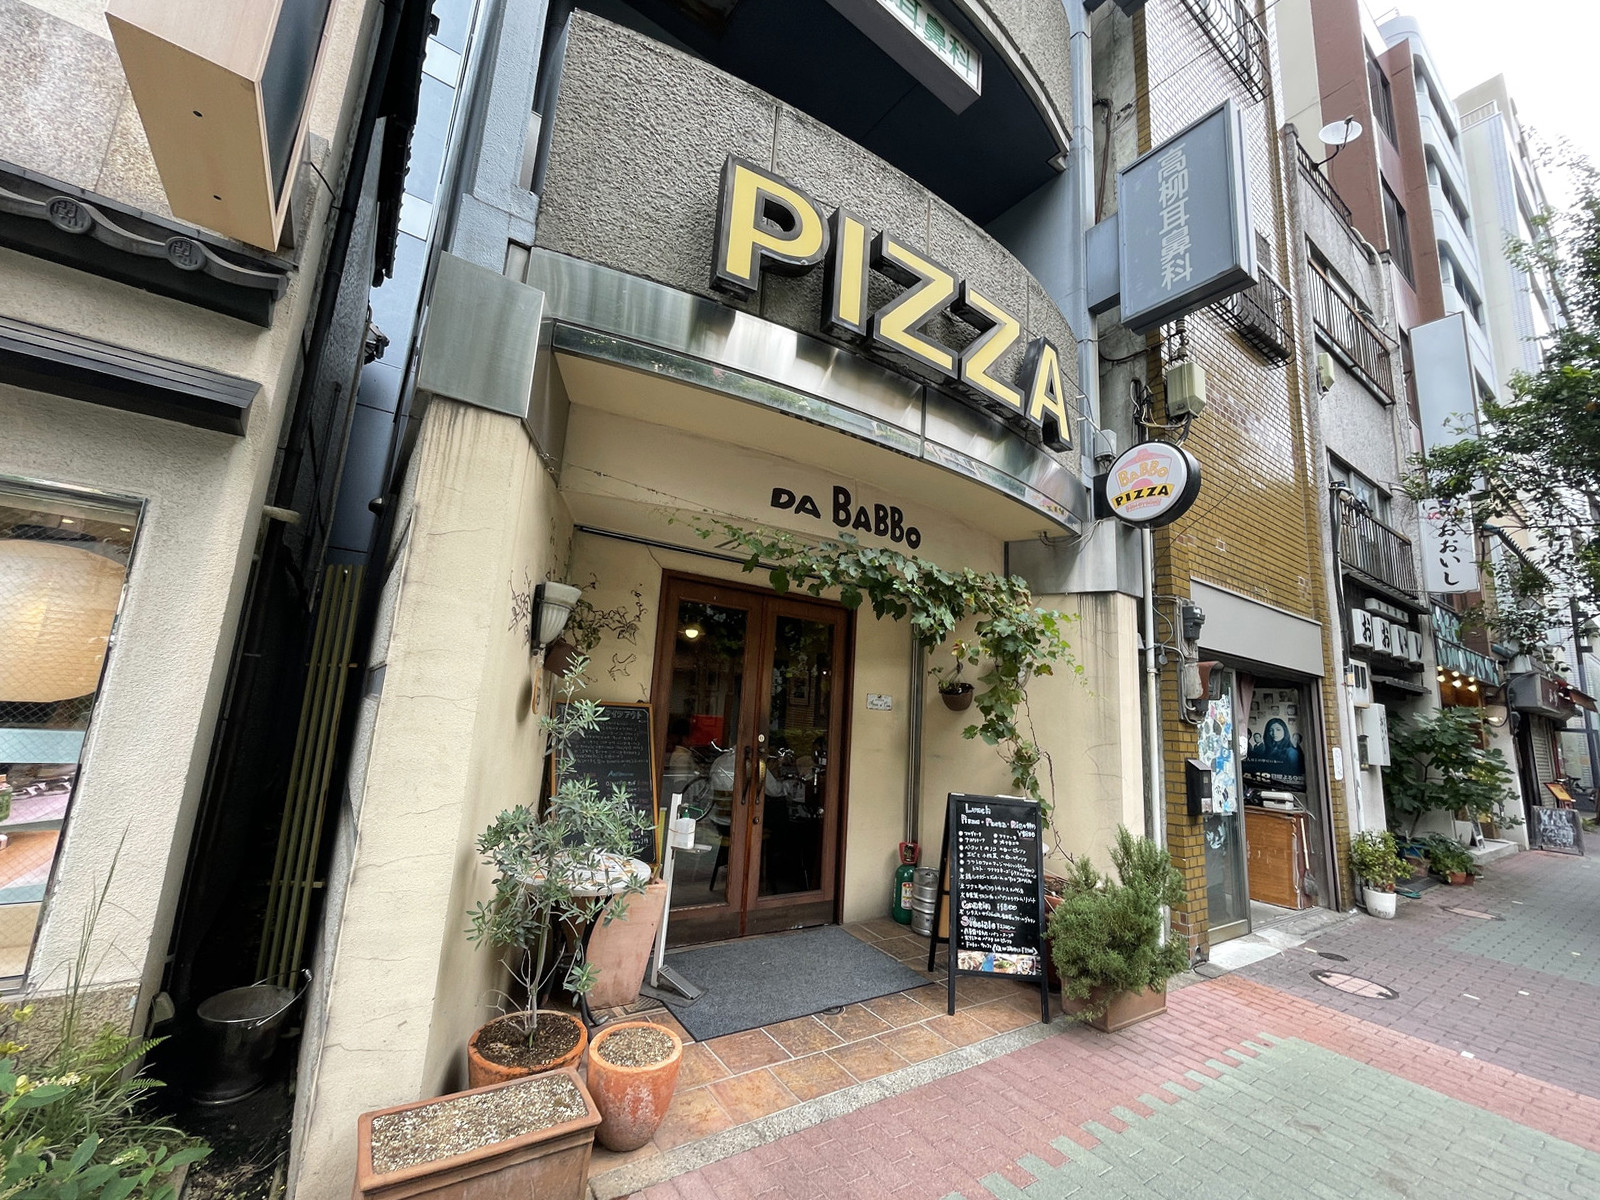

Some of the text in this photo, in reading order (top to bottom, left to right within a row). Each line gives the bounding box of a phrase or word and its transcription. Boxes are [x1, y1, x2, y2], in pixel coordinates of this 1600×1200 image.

[1157, 142, 1193, 291] 高柳耳鼻科
[712, 155, 1072, 450] PIZZA
[771, 487, 821, 519] DA
[1115, 485, 1169, 506] PIZZA
[1362, 613, 1422, 660] おおいし
